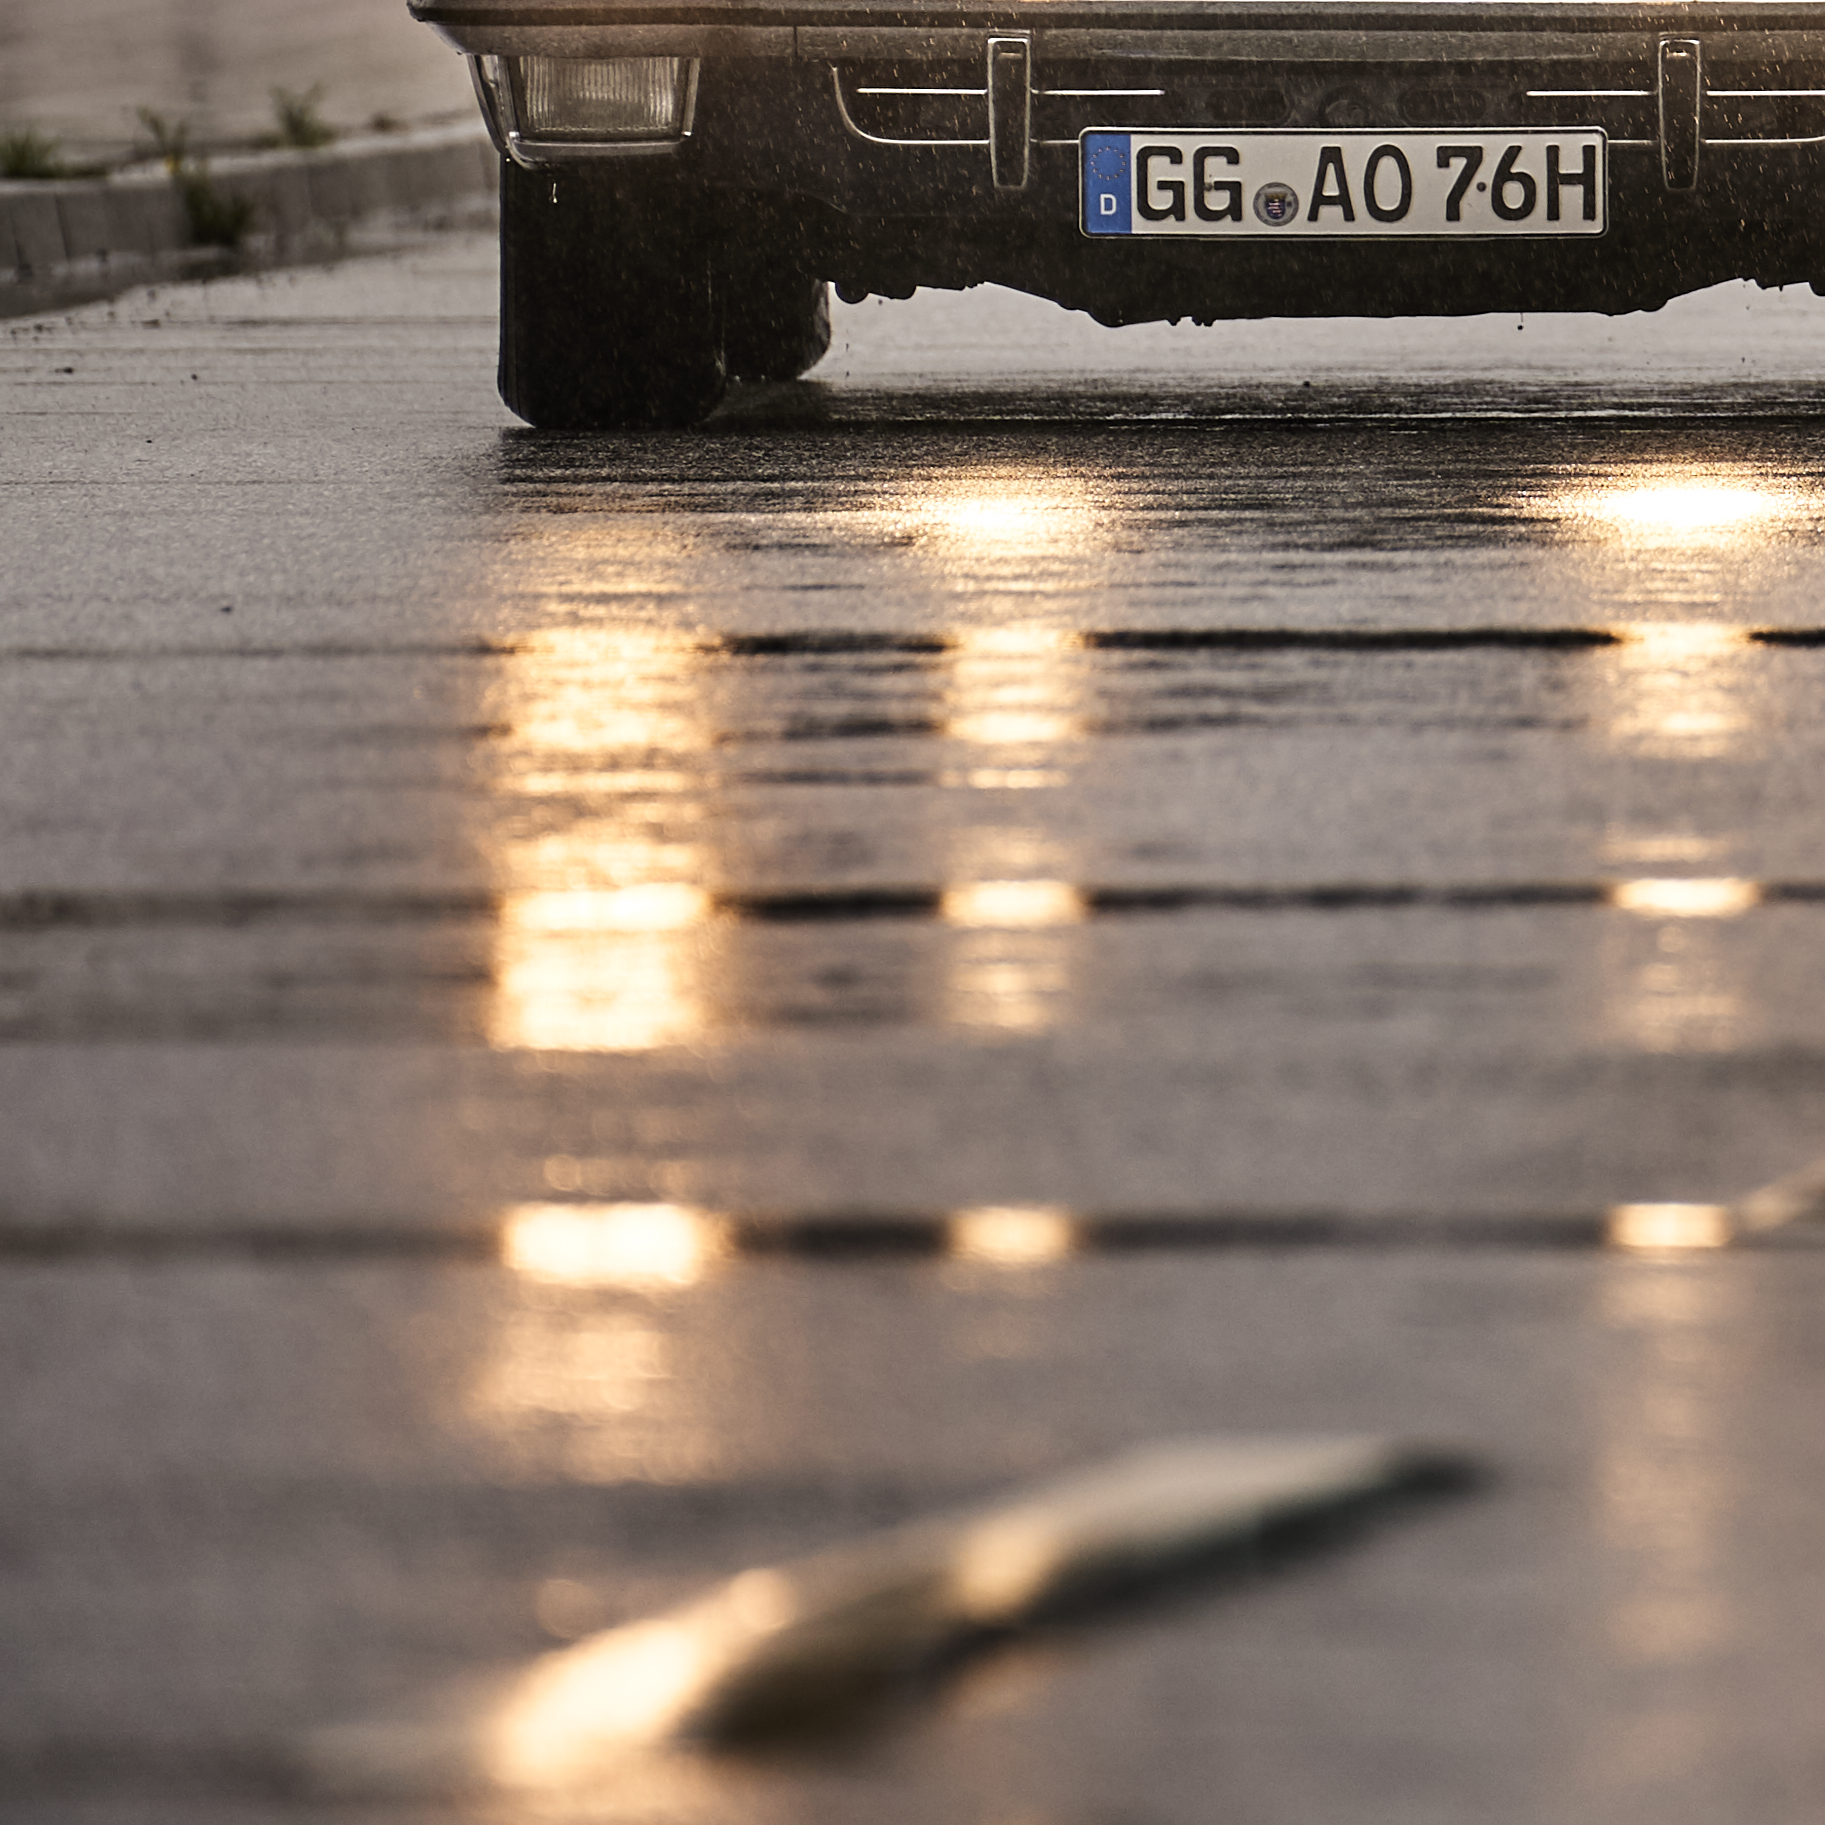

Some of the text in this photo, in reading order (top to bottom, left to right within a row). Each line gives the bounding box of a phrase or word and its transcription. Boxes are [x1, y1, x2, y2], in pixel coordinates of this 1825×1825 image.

[1100, 193, 1117, 215] D
[1136, 145, 1243, 222] GG
[1307, 144, 1413, 223] AO
[1437, 145, 1597, 222] 76H
